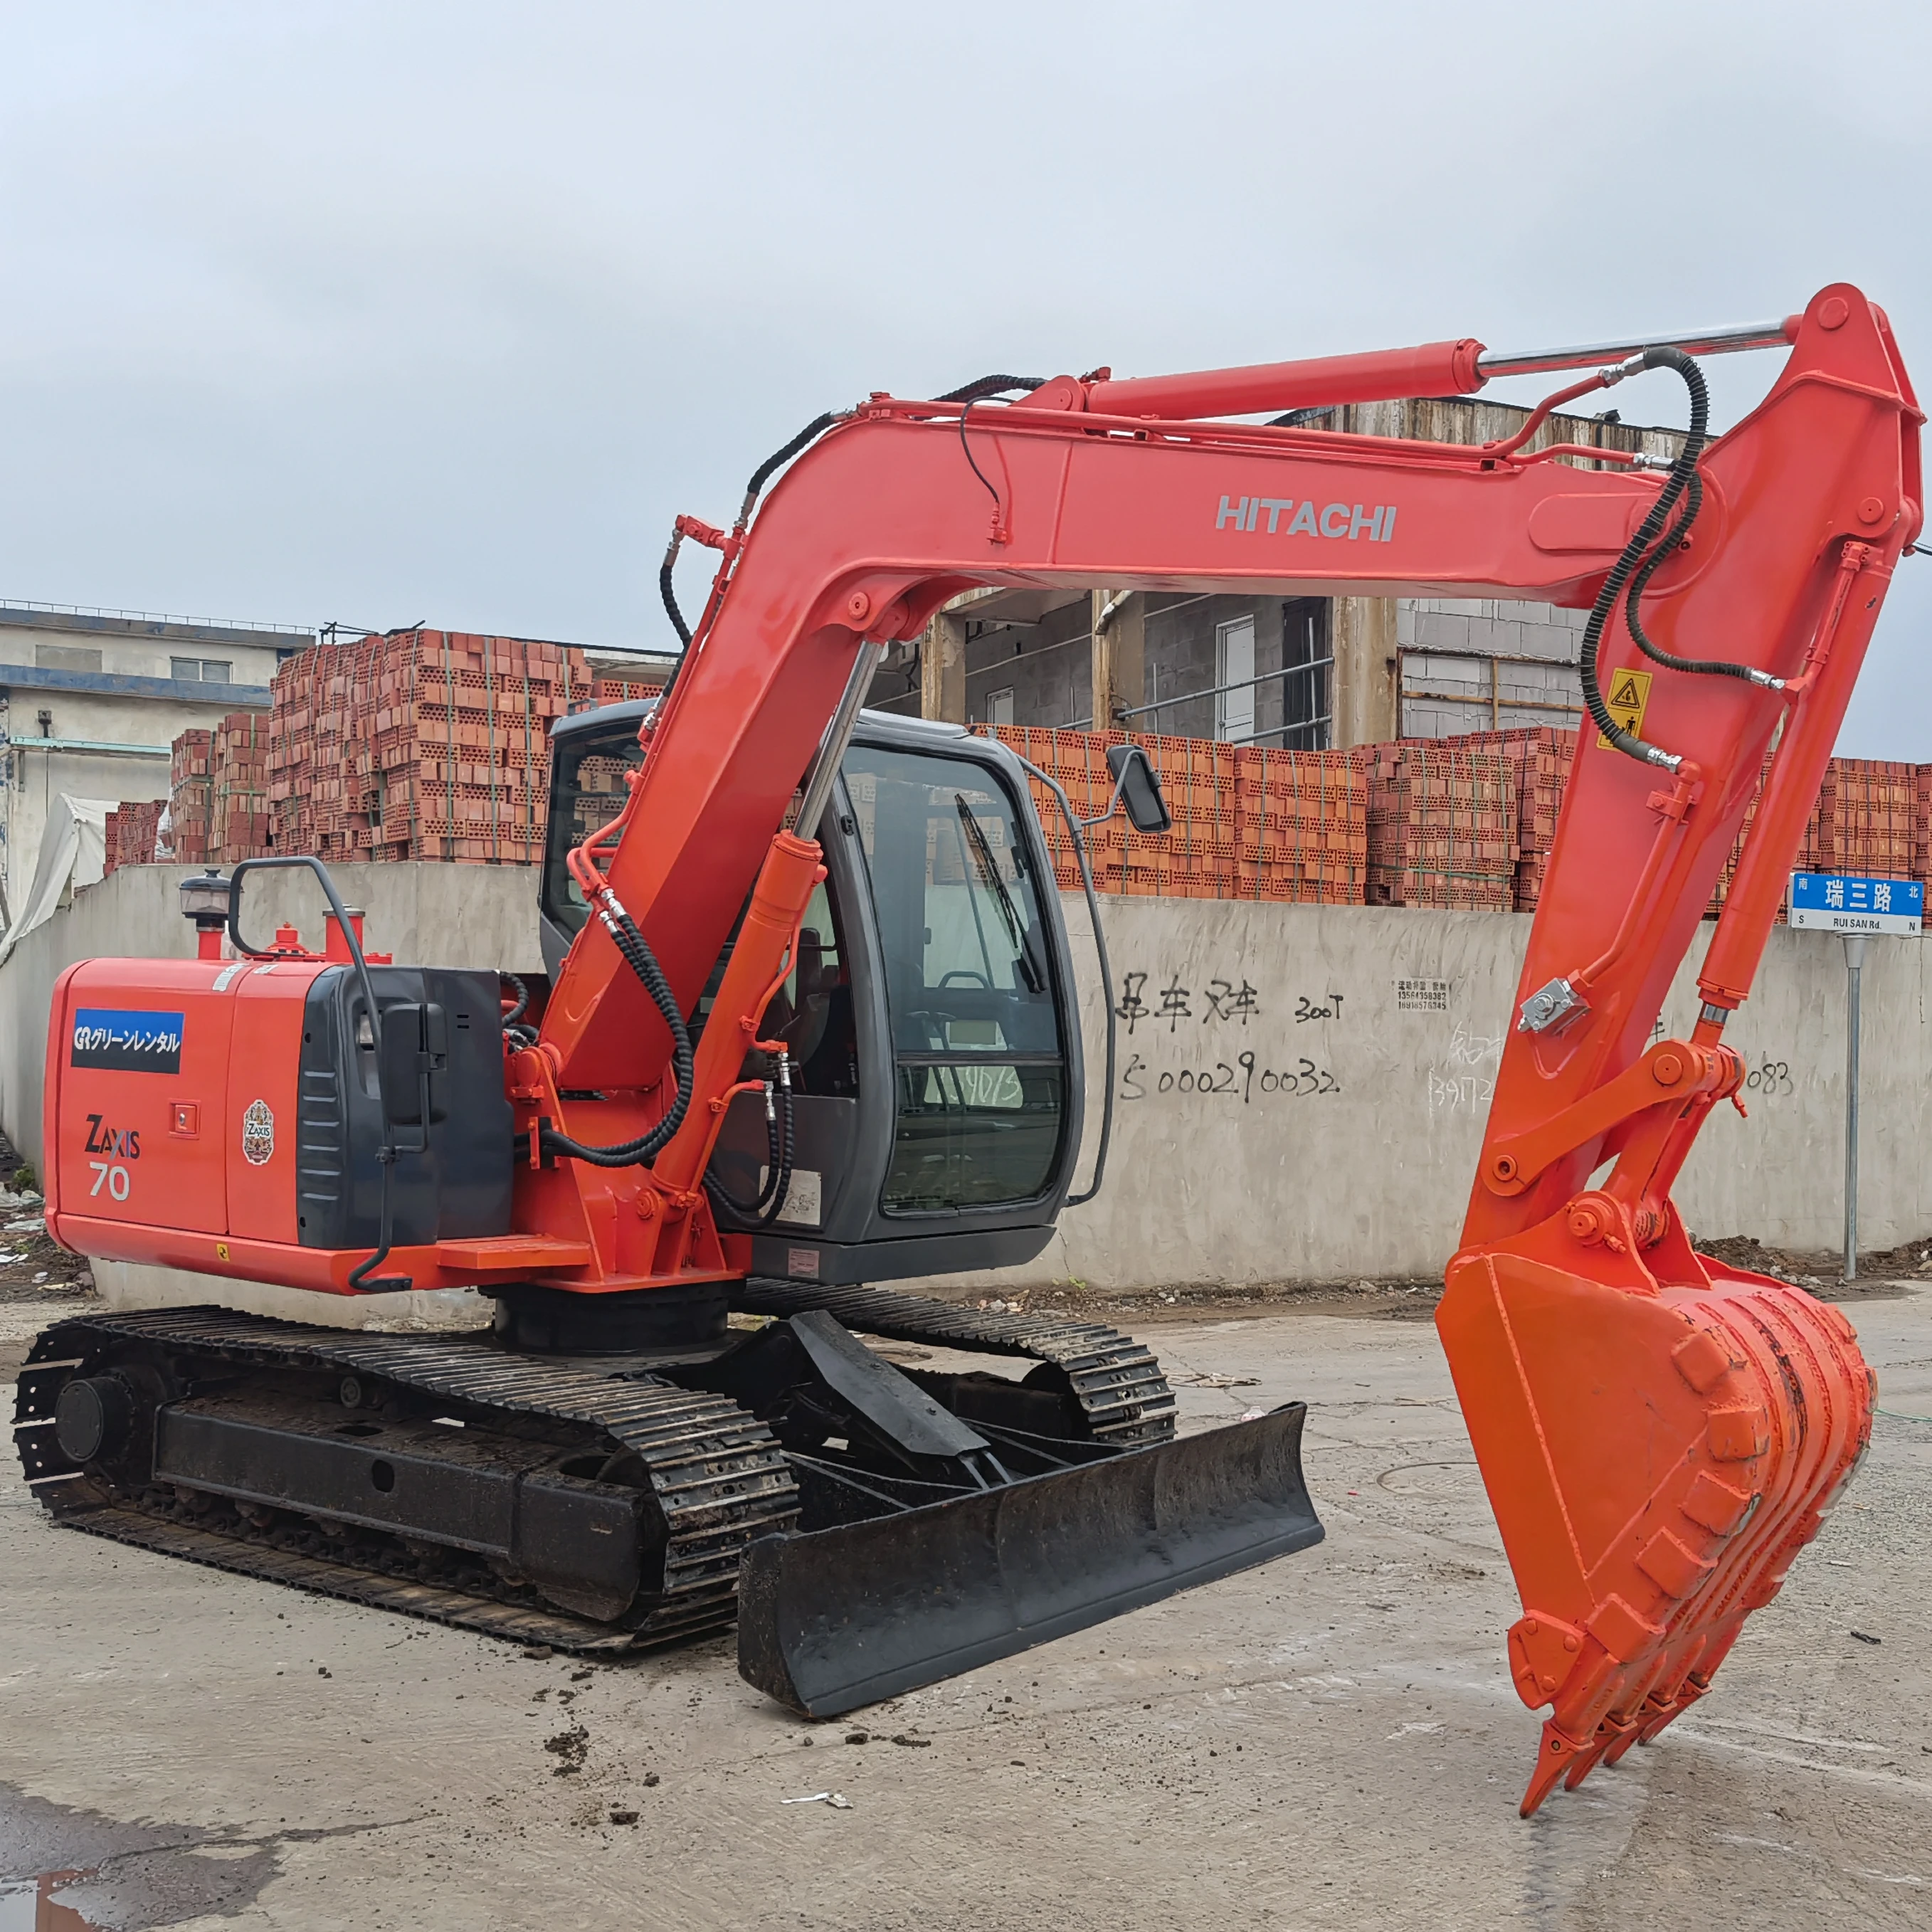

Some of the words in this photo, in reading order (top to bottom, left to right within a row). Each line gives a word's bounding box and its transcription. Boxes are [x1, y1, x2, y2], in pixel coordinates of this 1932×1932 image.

[1215, 495, 1397, 542] HITACHI
[1798, 877, 1808, 890] 南
[1825, 879, 1891, 912] 瑞三路
[1909, 885, 1918, 898] 北
[1798, 915, 1805, 924] S
[1833, 918, 1848, 927] RUI
[1849, 919, 1868, 929] SAN
[1869, 920, 1882, 930] Rd.
[1909, 922, 1916, 931] N
[1295, 995, 1344, 1023] 300T
[85, 1114, 140, 1161] ZAXIS
[248, 1123, 270, 1136] ZAXIS
[89, 1161, 130, 1201] 70
